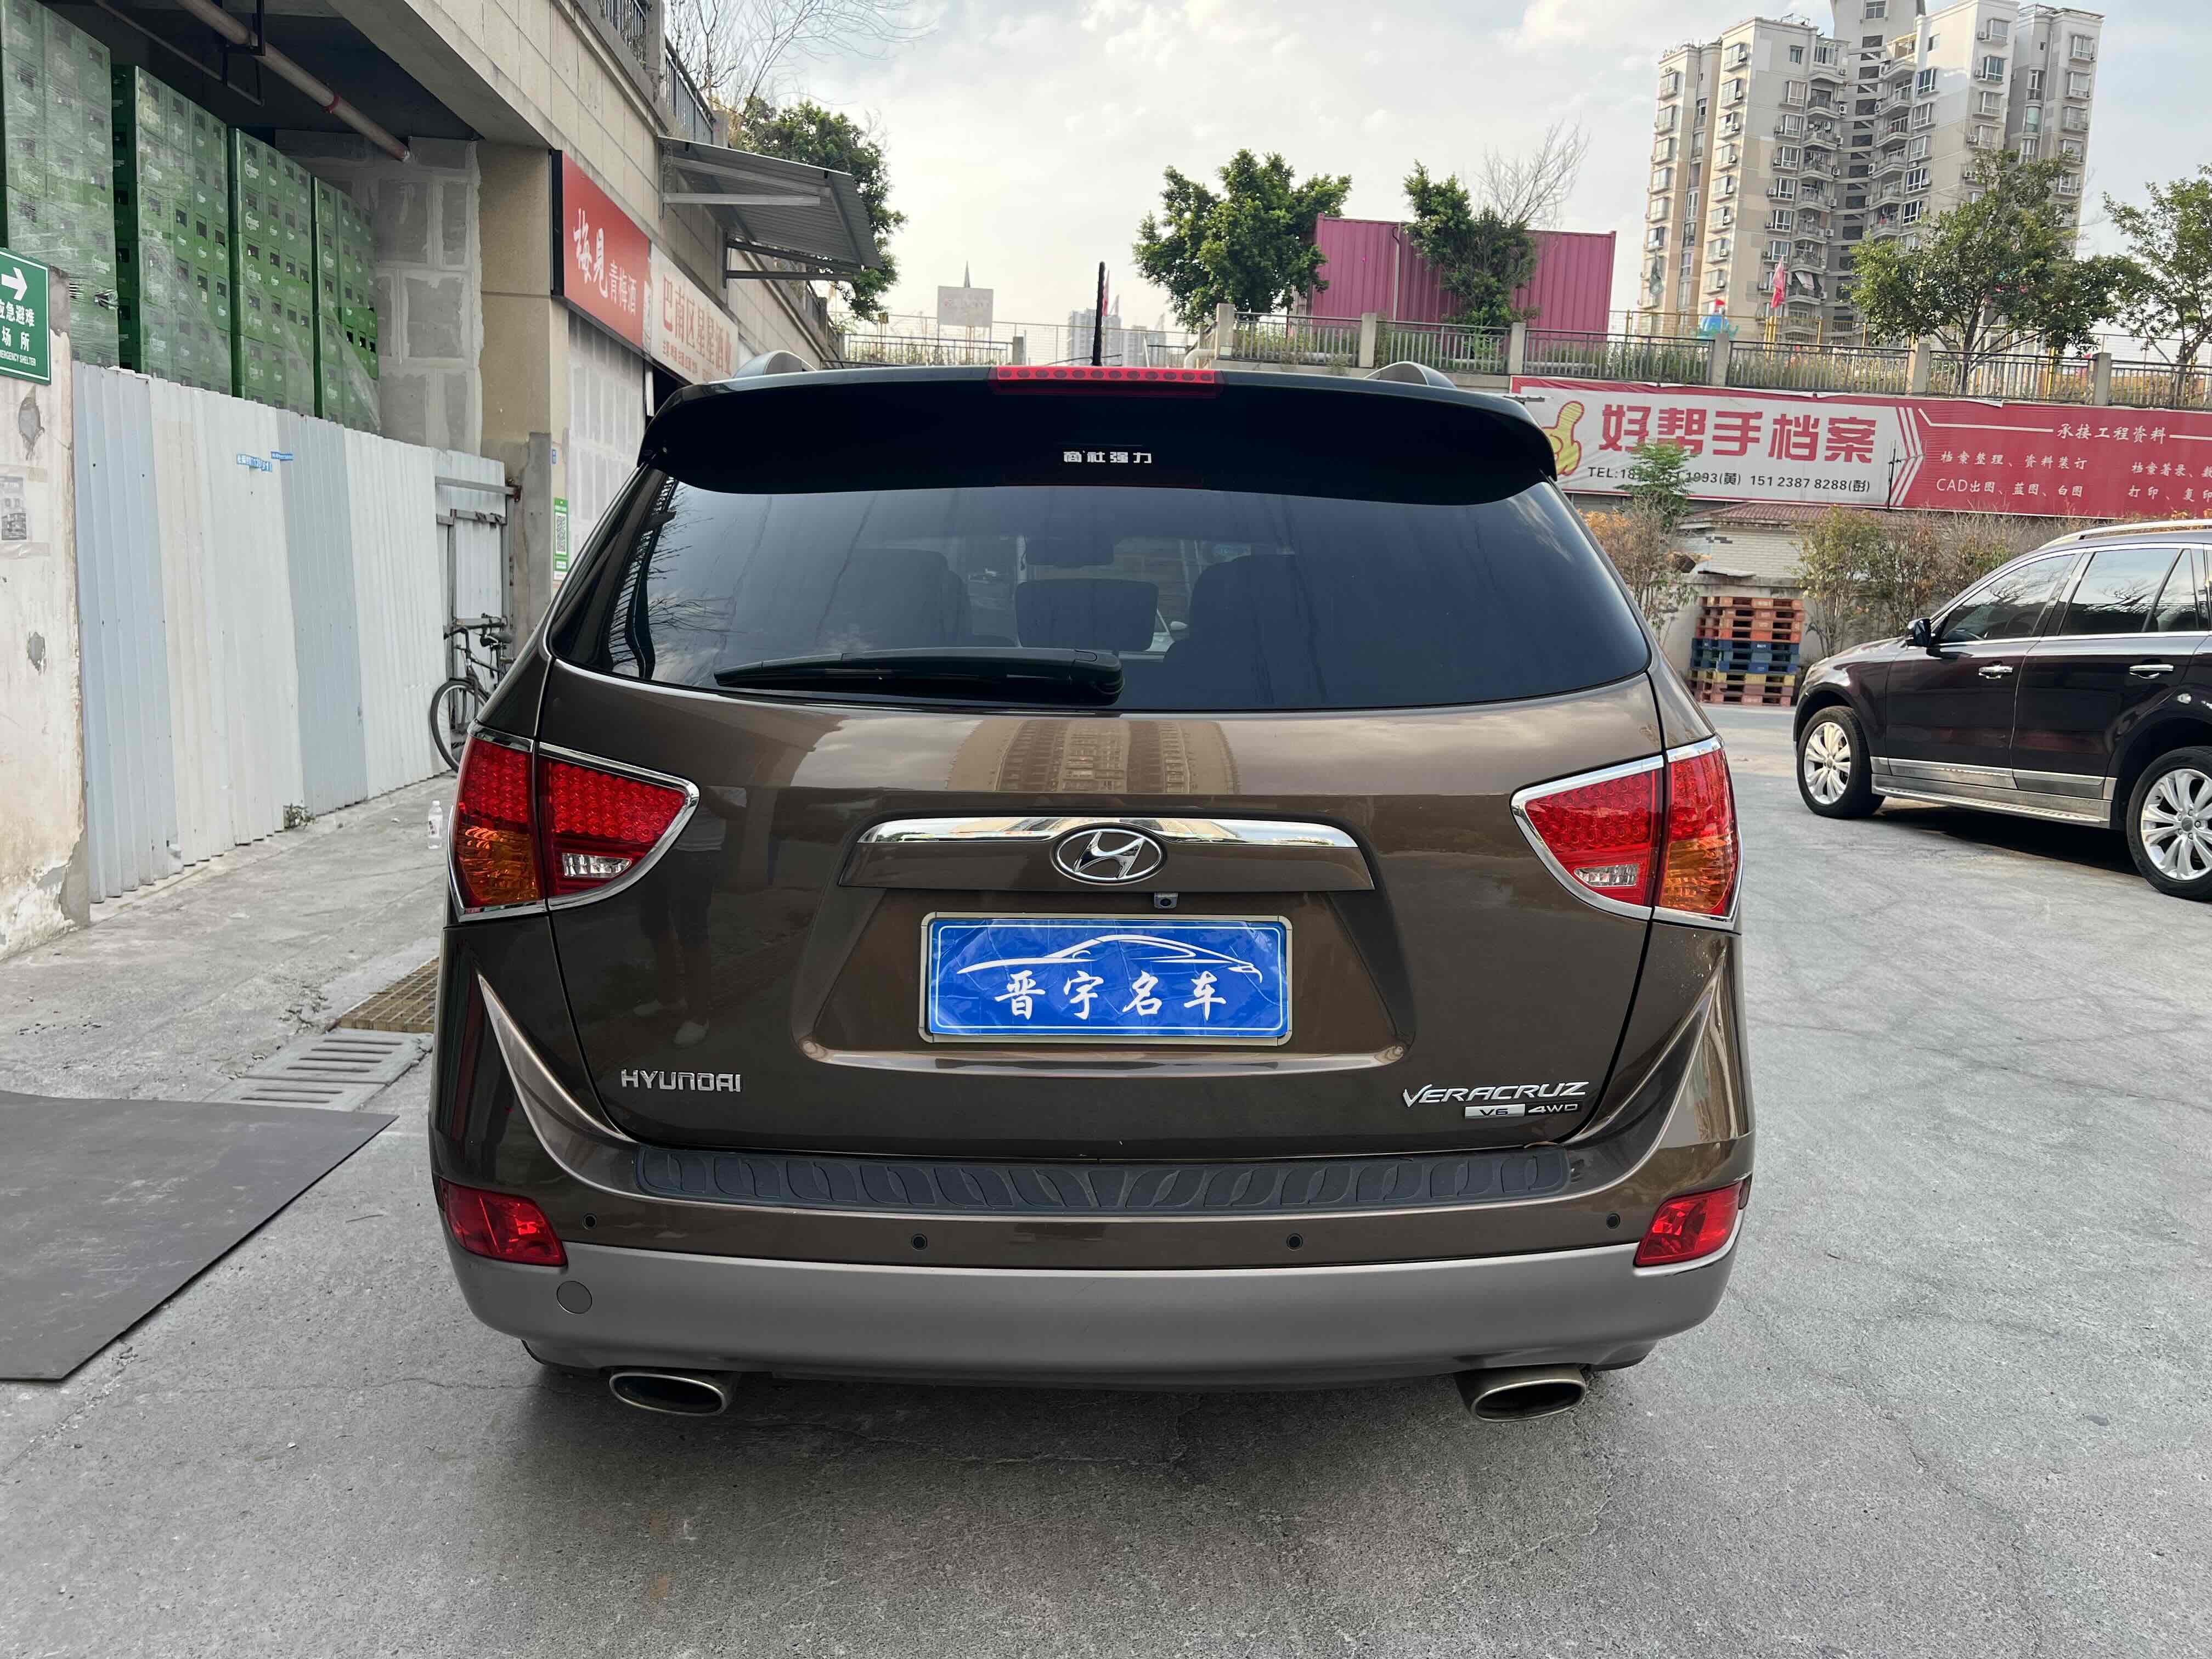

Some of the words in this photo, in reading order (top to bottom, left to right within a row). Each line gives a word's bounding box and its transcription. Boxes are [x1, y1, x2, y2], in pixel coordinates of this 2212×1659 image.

[2, 325, 30, 352] 场所
[19, 354, 36, 367] SHELTER
[1599, 403, 1877, 464] 好帮手档案
[2057, 423, 2166, 444] 承接工程资料
[1940, 450, 2087, 470] 档案整理、资料装订
[1750, 475, 1773, 487] 151
[1777, 476, 1810, 488] 2387
[1936, 478, 2084, 498] CAD出图、蓝图、白图
[995, 969, 1227, 1022] 晋宇名车
[621, 1069, 741, 1092] HYUNDAI
[1402, 1081, 1589, 1107] VERACRUZ
[1479, 1108, 1509, 1117] V6
[1528, 1103, 1578, 1115] 4WD
